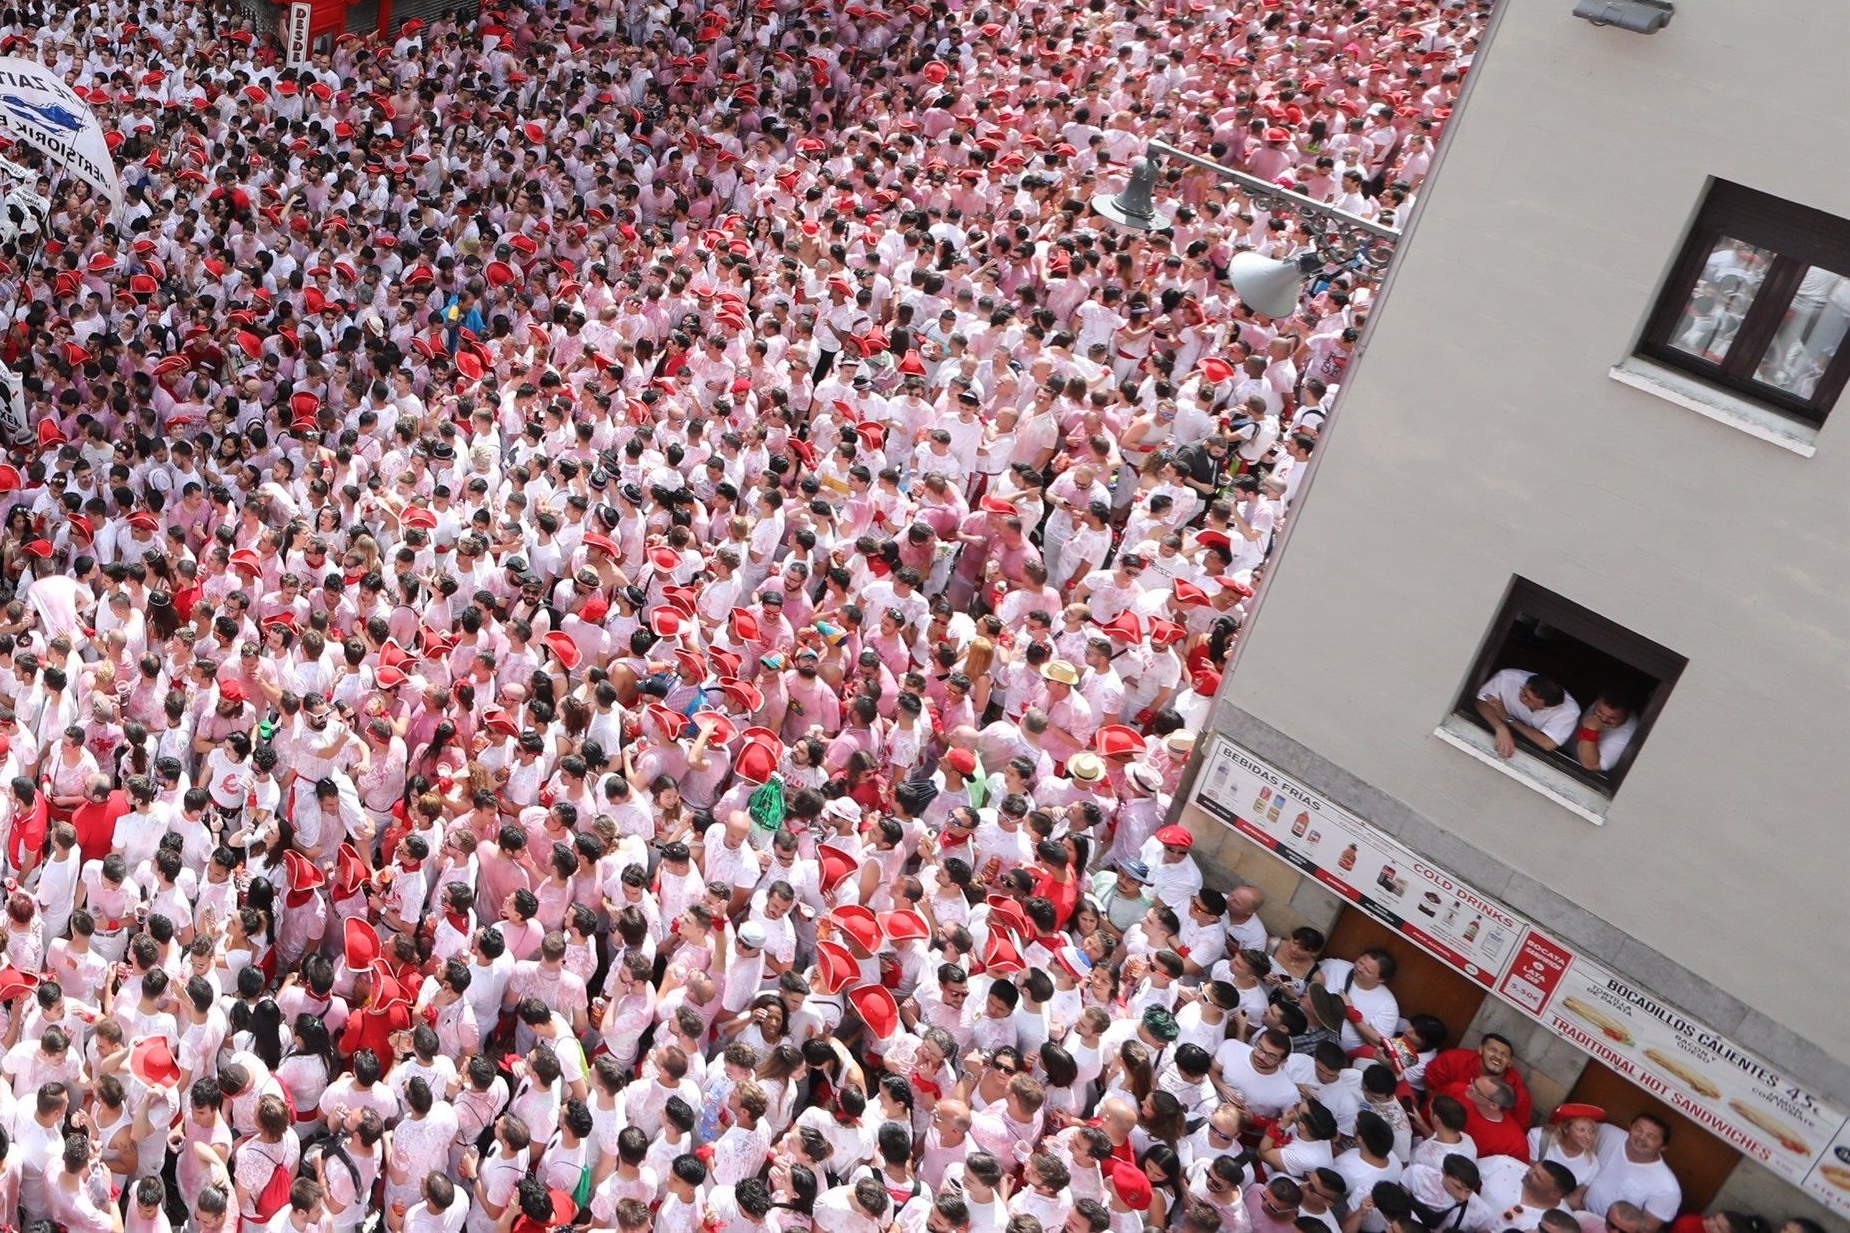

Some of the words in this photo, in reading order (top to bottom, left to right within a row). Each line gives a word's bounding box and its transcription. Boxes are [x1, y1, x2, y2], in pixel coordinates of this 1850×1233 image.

[293, 8, 307, 63] DESDE
[1222, 747, 1279, 785] BEBIDAS
[1413, 863, 1453, 891] COLD
[1456, 890, 1515, 928] DRINKS
[1526, 939, 1565, 966] BOCATA
[1522, 965, 1546, 983] LATA
[1591, 984, 1632, 1011] TORTILLA
[1599, 995, 1633, 1017] PATATA
[1606, 978, 1696, 1037] BOCADILLOS
[1697, 1033, 1781, 1088] CALIENTES
[1552, 1016, 1636, 1077] TRADITIONAL
[1639, 1070, 1671, 1097] HOT
[1673, 1091, 1772, 1163] SANDWICHES
